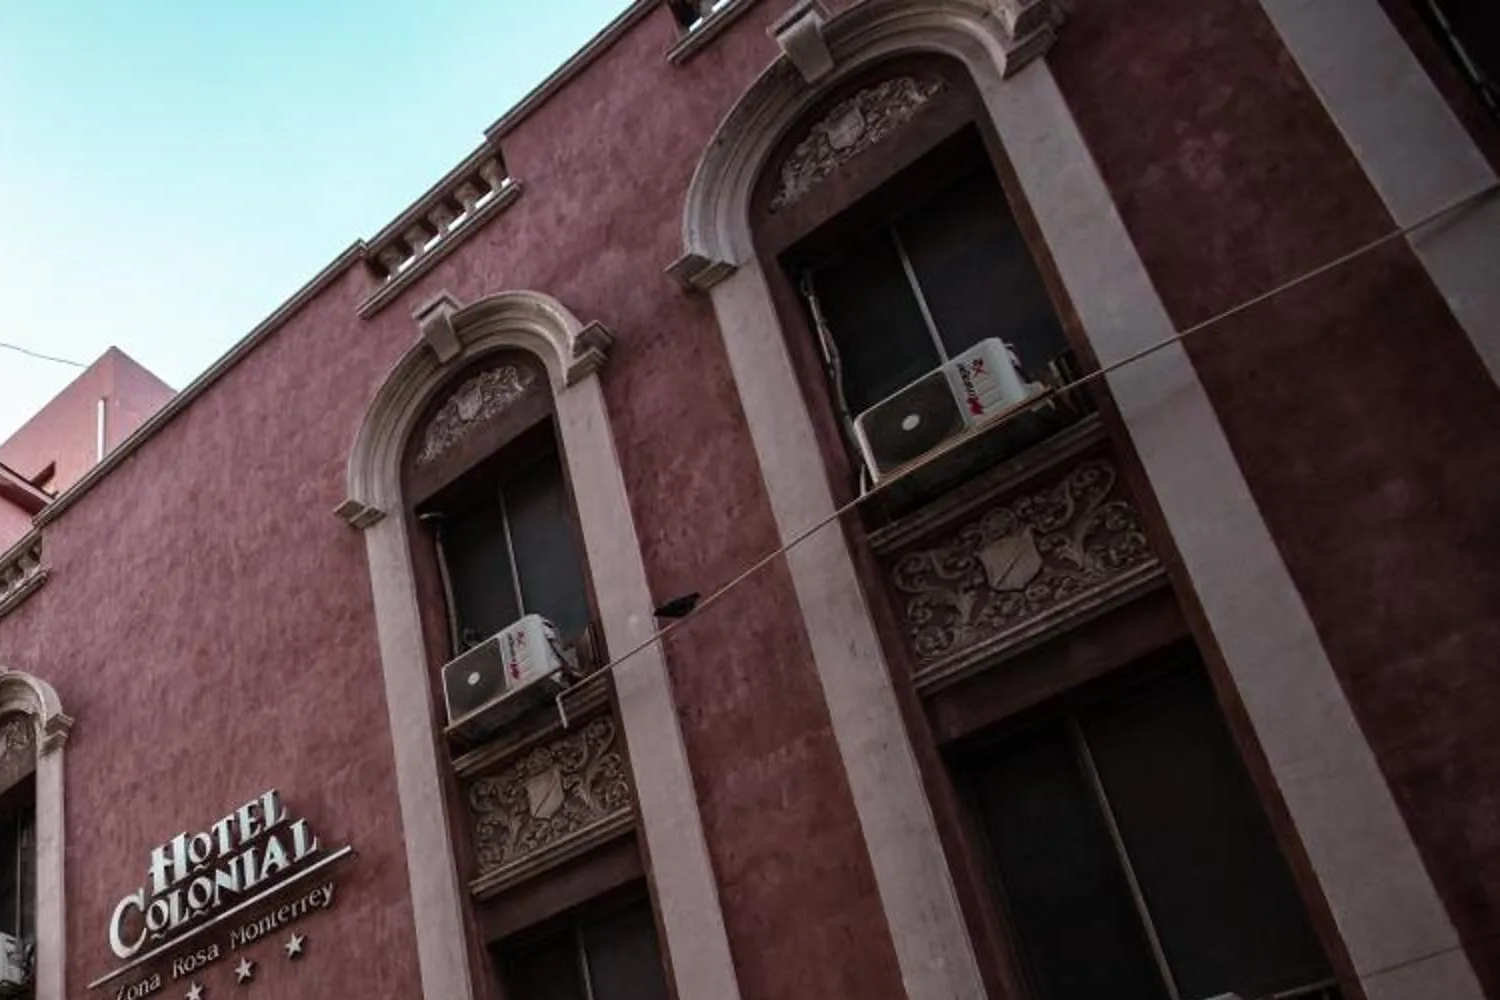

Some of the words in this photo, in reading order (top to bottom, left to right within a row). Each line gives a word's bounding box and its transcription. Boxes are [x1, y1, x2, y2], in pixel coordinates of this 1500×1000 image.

[109, 817, 317, 959] COLONIAL
[148, 788, 287, 895] HOTEL
[171, 943, 220, 980] Rosa
[230, 881, 335, 949] Monterrey
